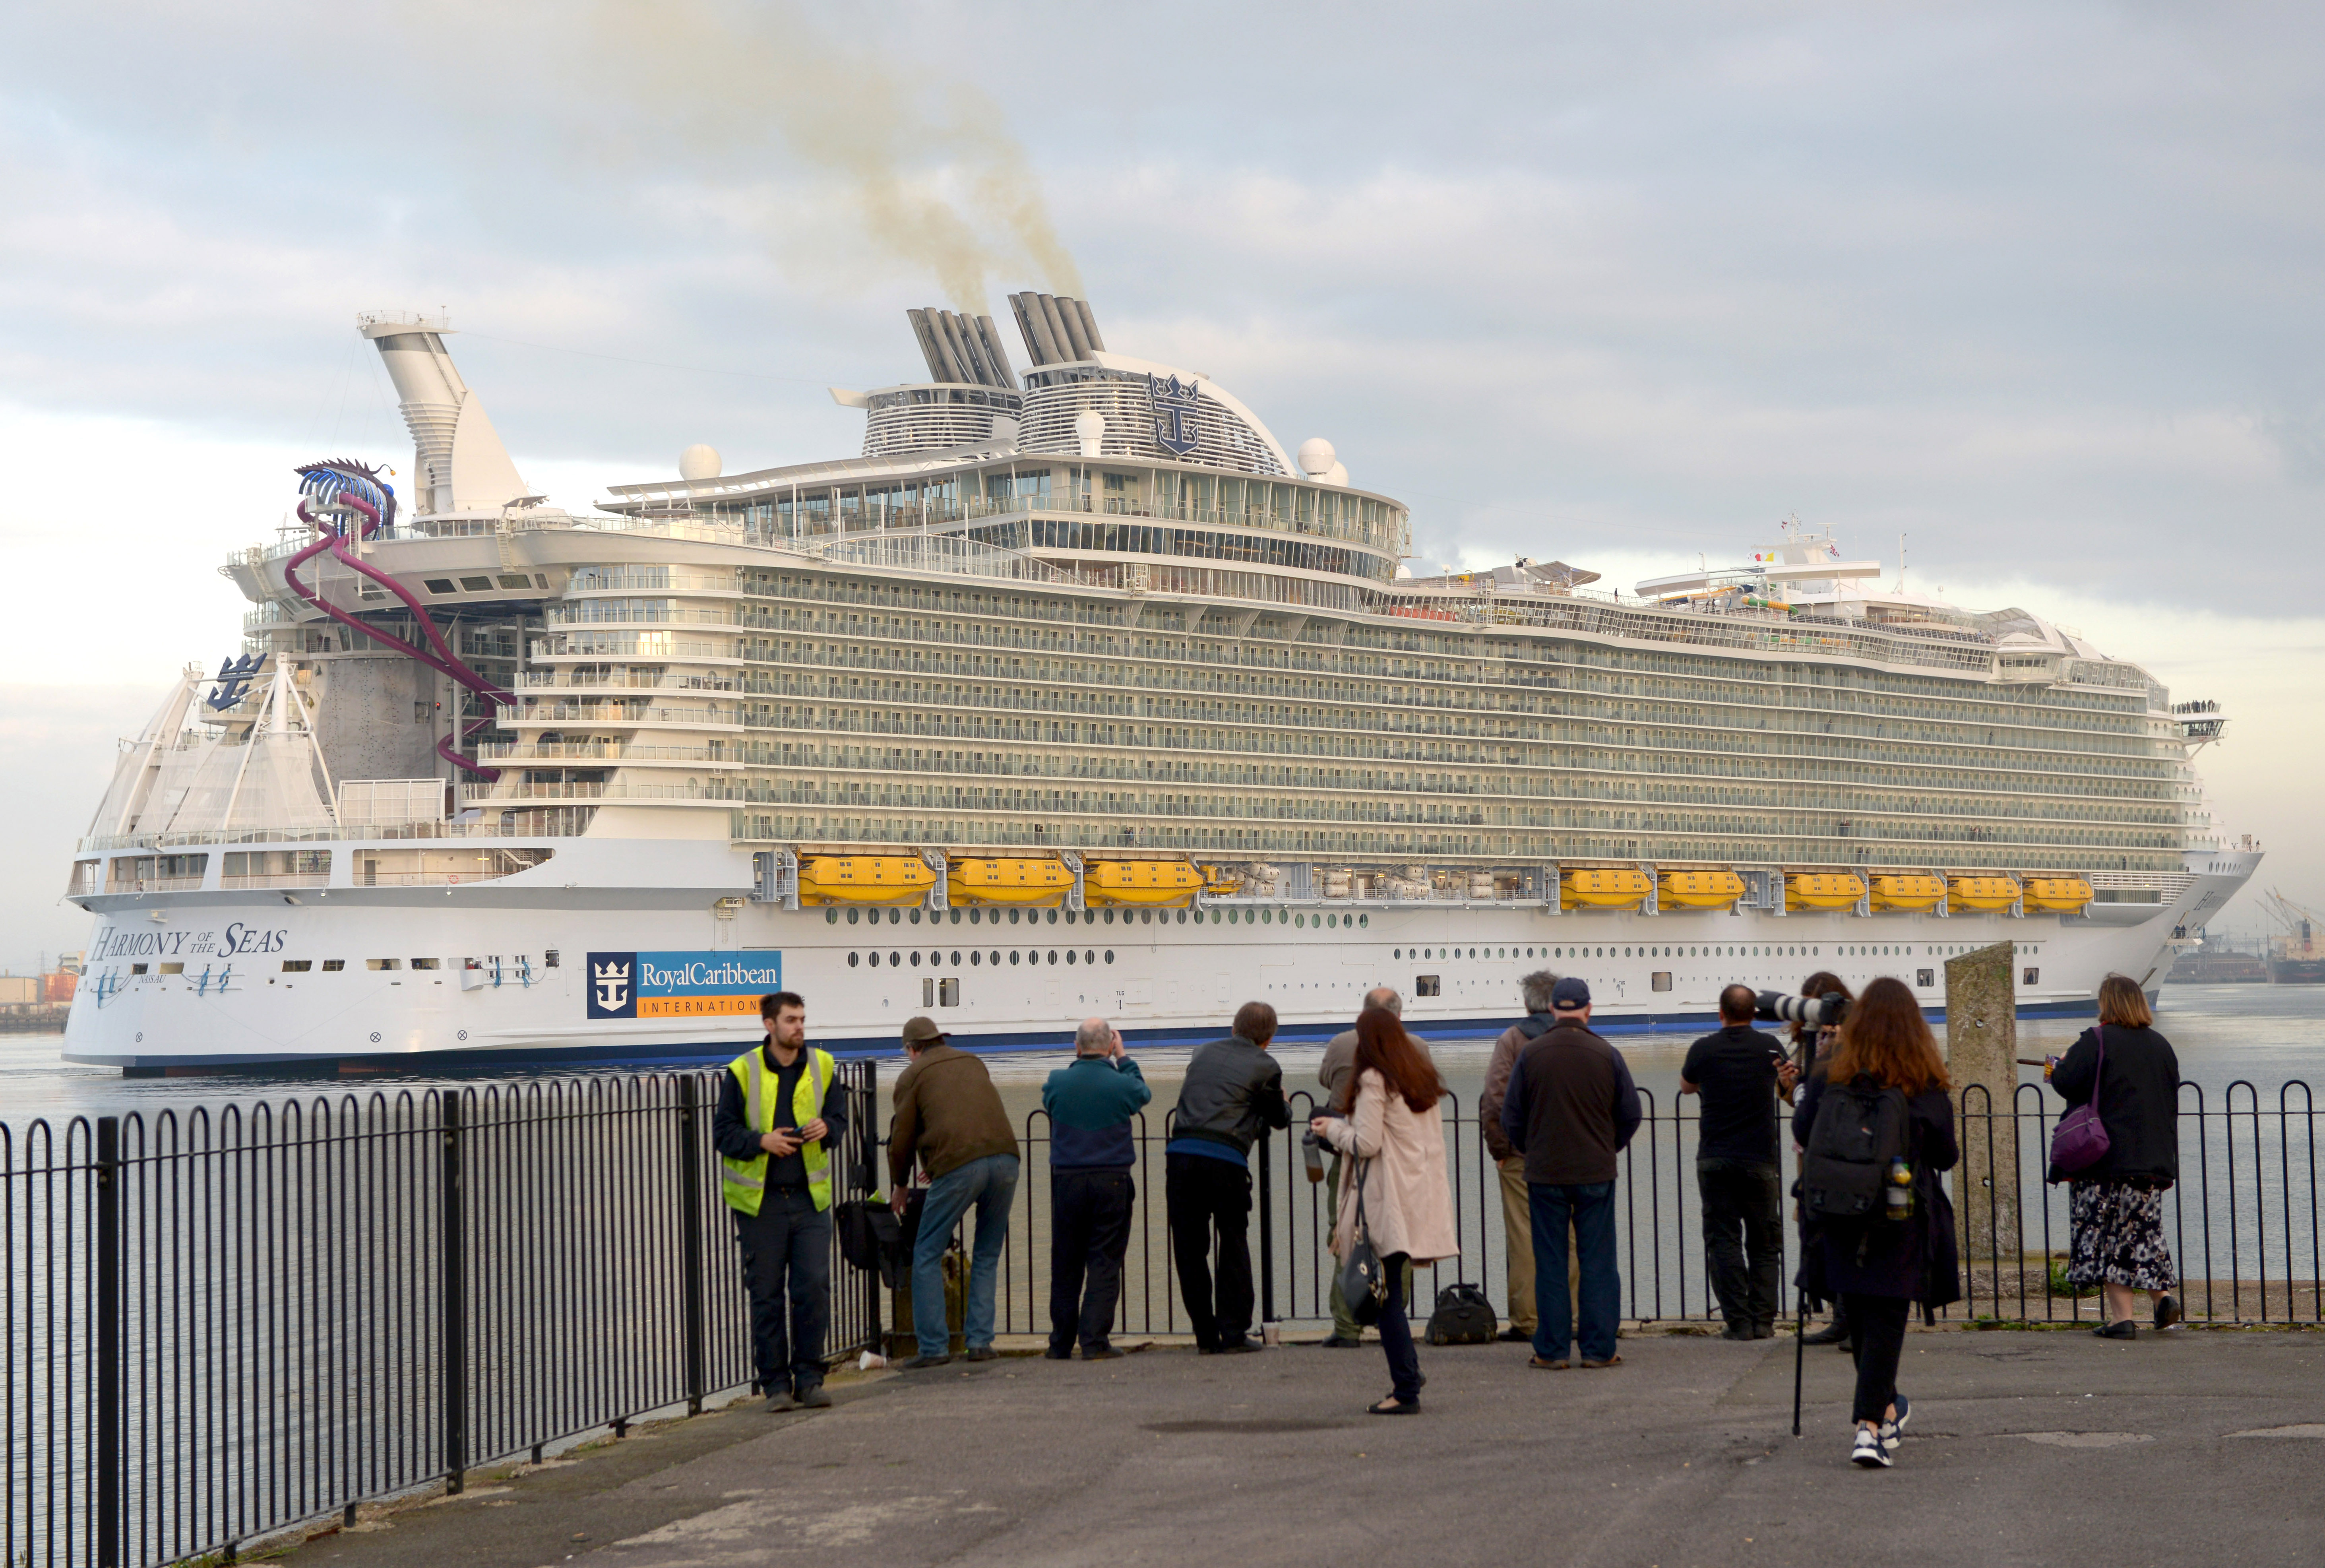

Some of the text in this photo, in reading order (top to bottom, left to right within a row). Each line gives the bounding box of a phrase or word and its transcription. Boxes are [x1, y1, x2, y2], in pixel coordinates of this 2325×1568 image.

[90, 922, 288, 961] HARMONY OF THE SEAS
[139, 975, 167, 984] NASSAU
[644, 1001, 756, 1013] INTERNATION
